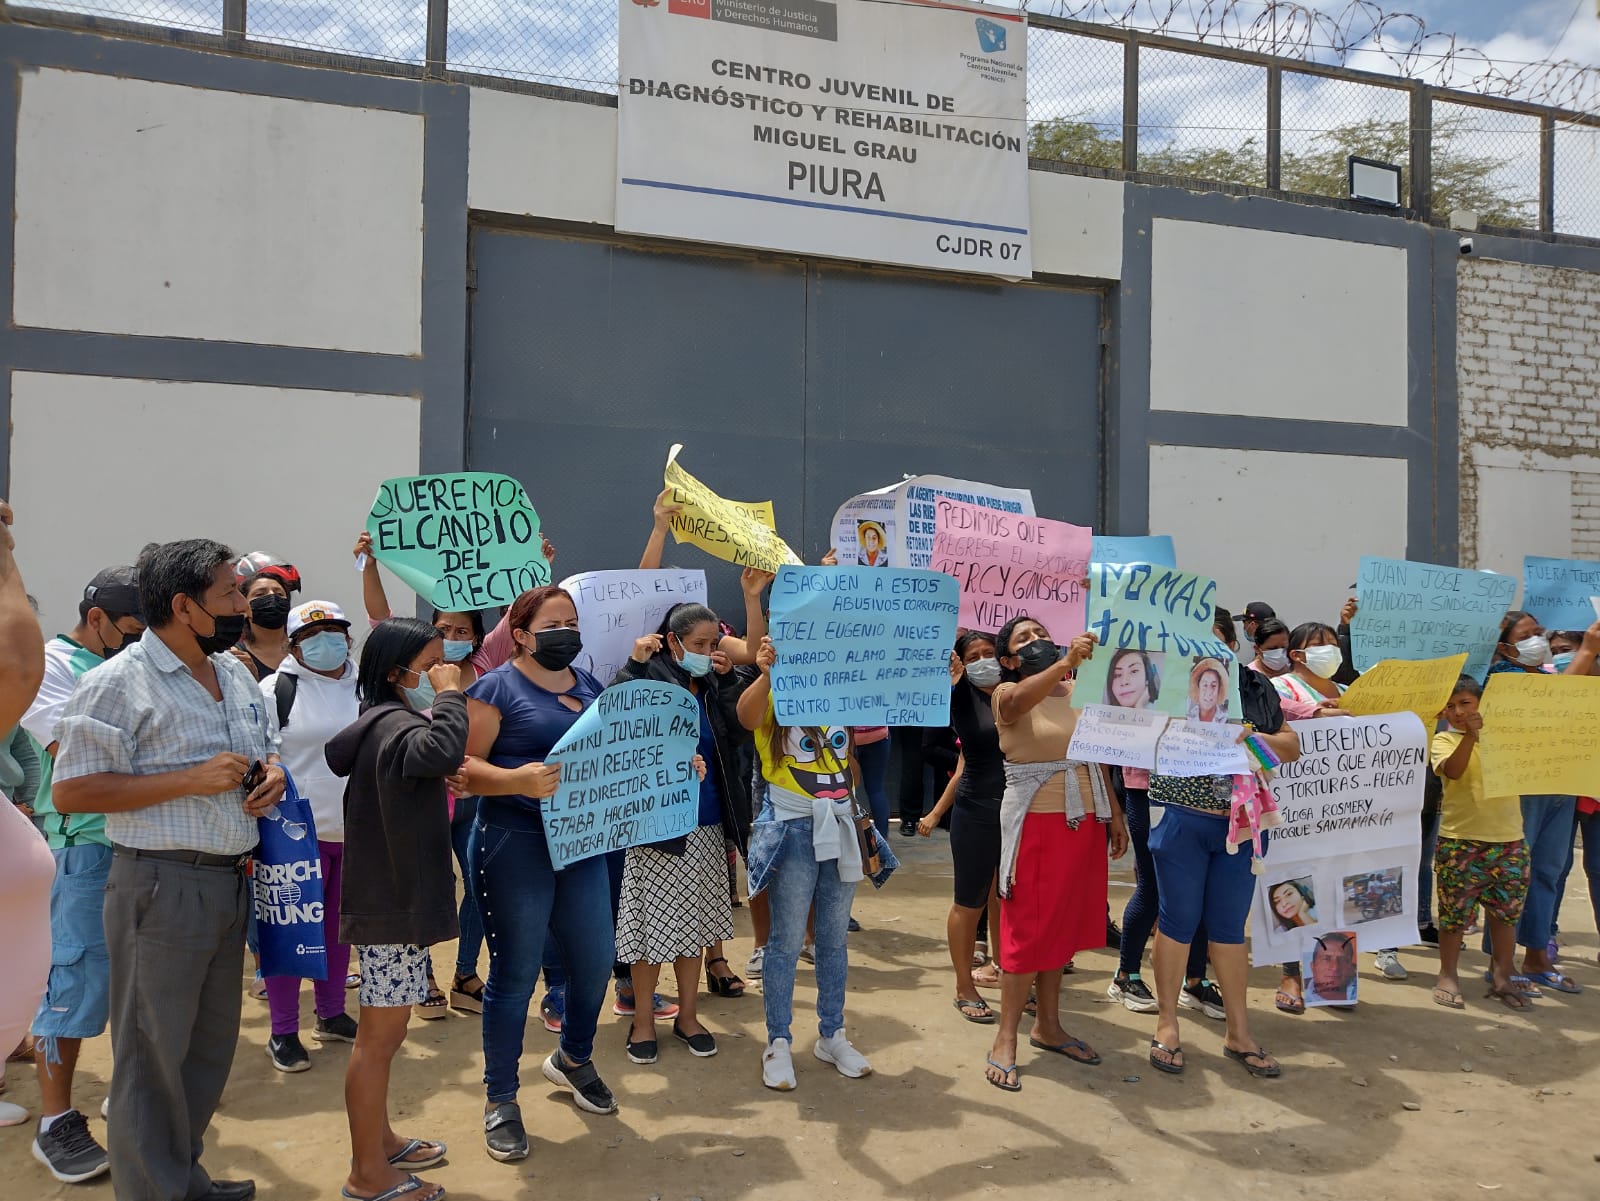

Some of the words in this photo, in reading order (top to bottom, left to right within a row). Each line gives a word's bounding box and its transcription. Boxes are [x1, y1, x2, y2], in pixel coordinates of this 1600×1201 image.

[716, 9, 722, 18] y
[724, 8, 771, 25] Derechos
[773, 18, 819, 34] Humanos
[768, 7, 781, 16] de
[783, 8, 818, 23] Justicia
[960, 52, 990, 64] Programa
[990, 58, 1016, 70] Nacional
[966, 61, 991, 72] Centros
[711, 59, 811, 90] CENTRO
[818, 77, 919, 107] JUVENIL
[926, 93, 955, 113] DE
[629, 78, 804, 118] DIAGNÓSTICO
[811, 104, 828, 121] Y
[835, 108, 1021, 152] REHABILITACIÓN
[753, 124, 847, 155] MIGUEL
[853, 140, 918, 164] GRAU
[788, 160, 886, 202] PIURA
[936, 234, 993, 258] CJDR
[999, 242, 1022, 261] 07
[370, 477, 533, 518] QUEREMOS
[910, 502, 922, 518] LAS
[909, 520, 920, 533] DE
[1017, 521, 1045, 545] QUE
[438, 548, 490, 574] DEL
[934, 532, 1000, 558] REGRESE
[1011, 545, 1025, 565] EL
[783, 571, 859, 594] SAQUEN
[875, 577, 883, 593] A
[891, 577, 941, 594] ESTOS
[936, 558, 1012, 597] PERCY
[1363, 562, 1408, 586] JUAN
[1420, 569, 1463, 592] JOSE
[1473, 577, 1517, 598] SOSA
[1527, 565, 1568, 581] FUERA
[570, 577, 644, 604] FUERA
[654, 579, 674, 592] EL
[1359, 589, 1423, 611] MENDOZA
[832, 595, 901, 612] ABUSIVOS
[903, 598, 960, 615] CORRUPTOS
[775, 621, 817, 641] JOEL
[825, 621, 885, 640] EUGENIO
[893, 624, 941, 640] NIEVES
[1354, 617, 1391, 634] LLEGA
[1399, 619, 1406, 633] A
[845, 649, 887, 664] ALAMO
[1352, 634, 1407, 649] TRABAJA
[1415, 638, 1426, 652] Y
[1431, 640, 1449, 653] ES
[824, 669, 868, 686] RAFAEL
[777, 698, 831, 716] CENTRO
[838, 695, 890, 712] JUVENIL
[896, 691, 947, 706] MIGUEL
[885, 708, 925, 725] GRAU
[607, 713, 664, 745] JUVENIL
[1299, 723, 1392, 757] UEREMOS
[603, 744, 664, 776] REGRESE
[1272, 756, 1330, 780] OLOGOS
[1337, 753, 1367, 773] QUE
[1371, 747, 1425, 771] APOYEN
[1286, 774, 1360, 801] TORTURAS
[1373, 769, 1415, 788] FUERA
[545, 811, 595, 838] STABA
[603, 795, 655, 826] HACIENDO
[660, 788, 692, 809] UNA
[1315, 807, 1394, 834] SANTAMARÍA
[1322, 798, 1374, 819] ROSMERY
[554, 831, 604, 862] DADERA
[254, 901, 324, 925] STIFTUNG
